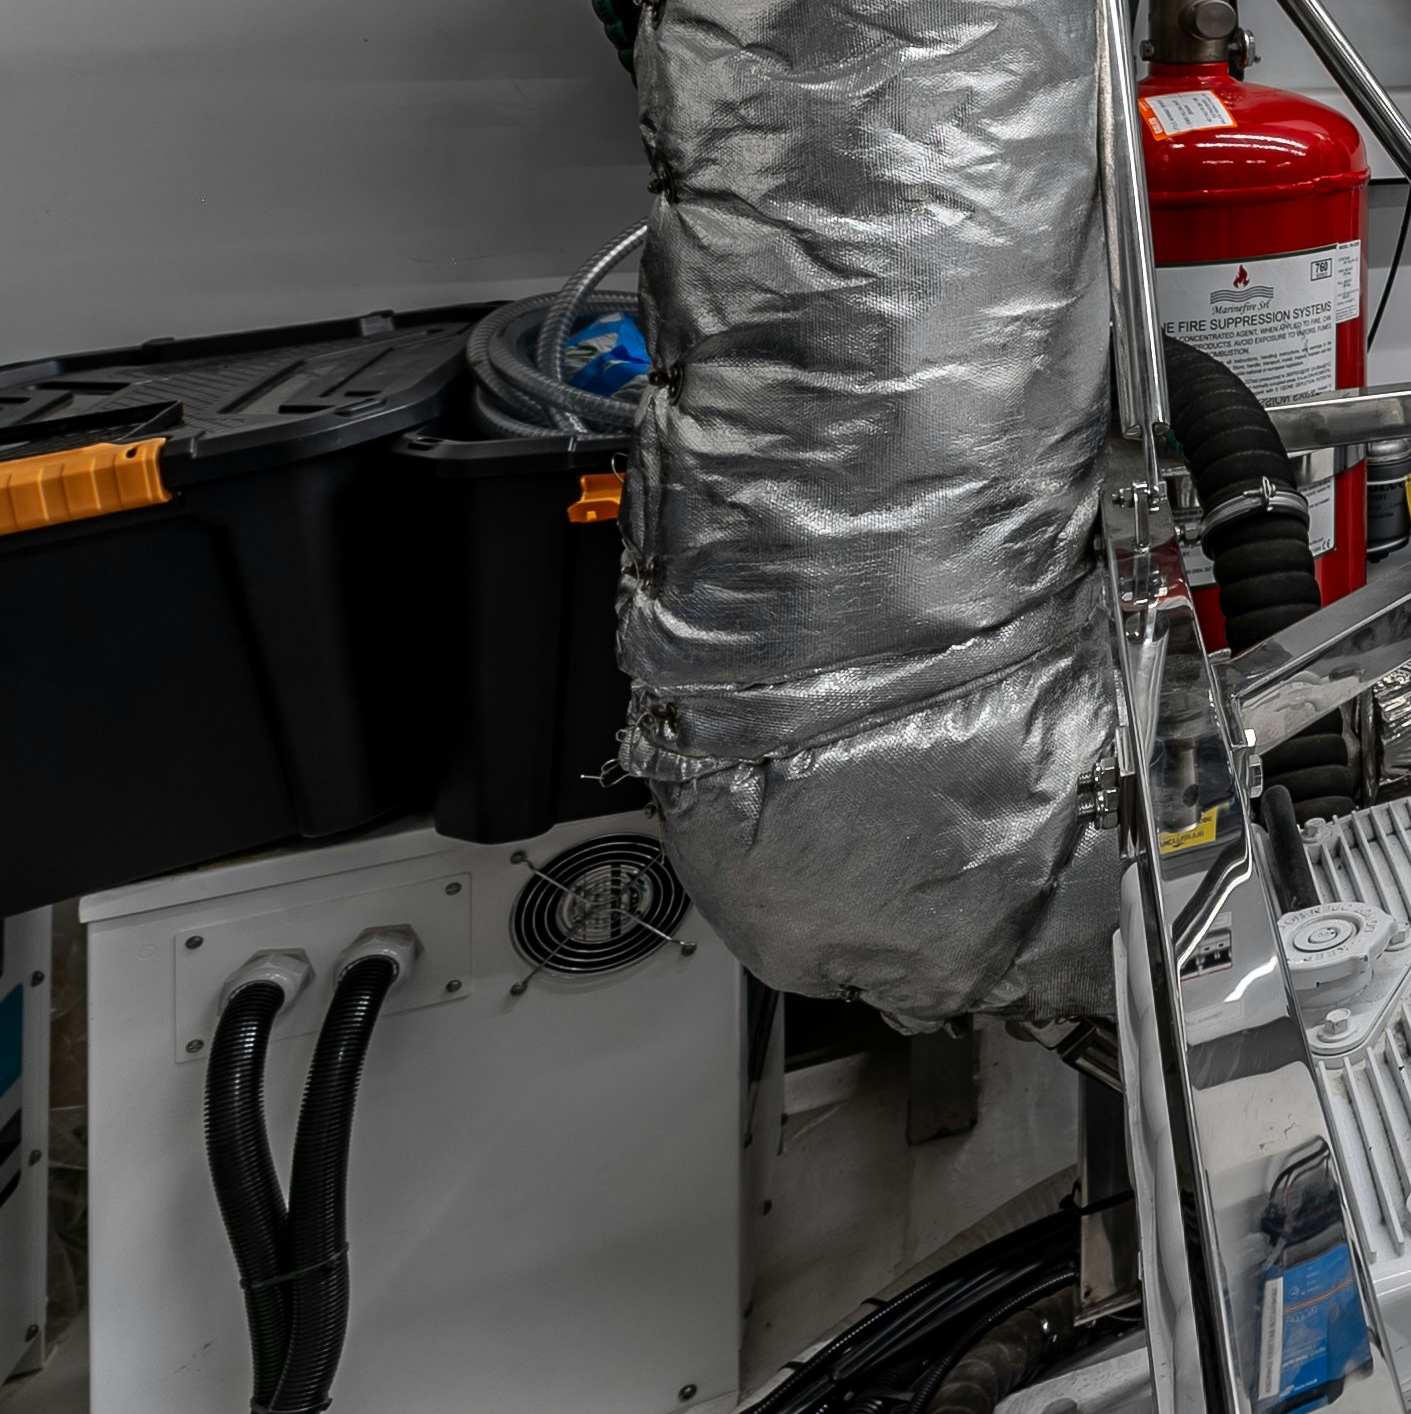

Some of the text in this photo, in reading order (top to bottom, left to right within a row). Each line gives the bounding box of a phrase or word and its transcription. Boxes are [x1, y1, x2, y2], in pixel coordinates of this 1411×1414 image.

[1315, 261, 1329, 273] 760
[1212, 300, 1270, 316] Marinefire Srl
[1178, 319, 1207, 334] FIRE
[1209, 309, 1291, 331] SUPPRESSION
[1292, 301, 1332, 320] SYSTEMS
[1259, 325, 1278, 335] WHEN
[1278, 322, 1302, 333] APPLIED
[1233, 338, 1254, 346] AVOID
[1254, 334, 1286, 345] EXPOSURE
[1287, 331, 1296, 339] TO
